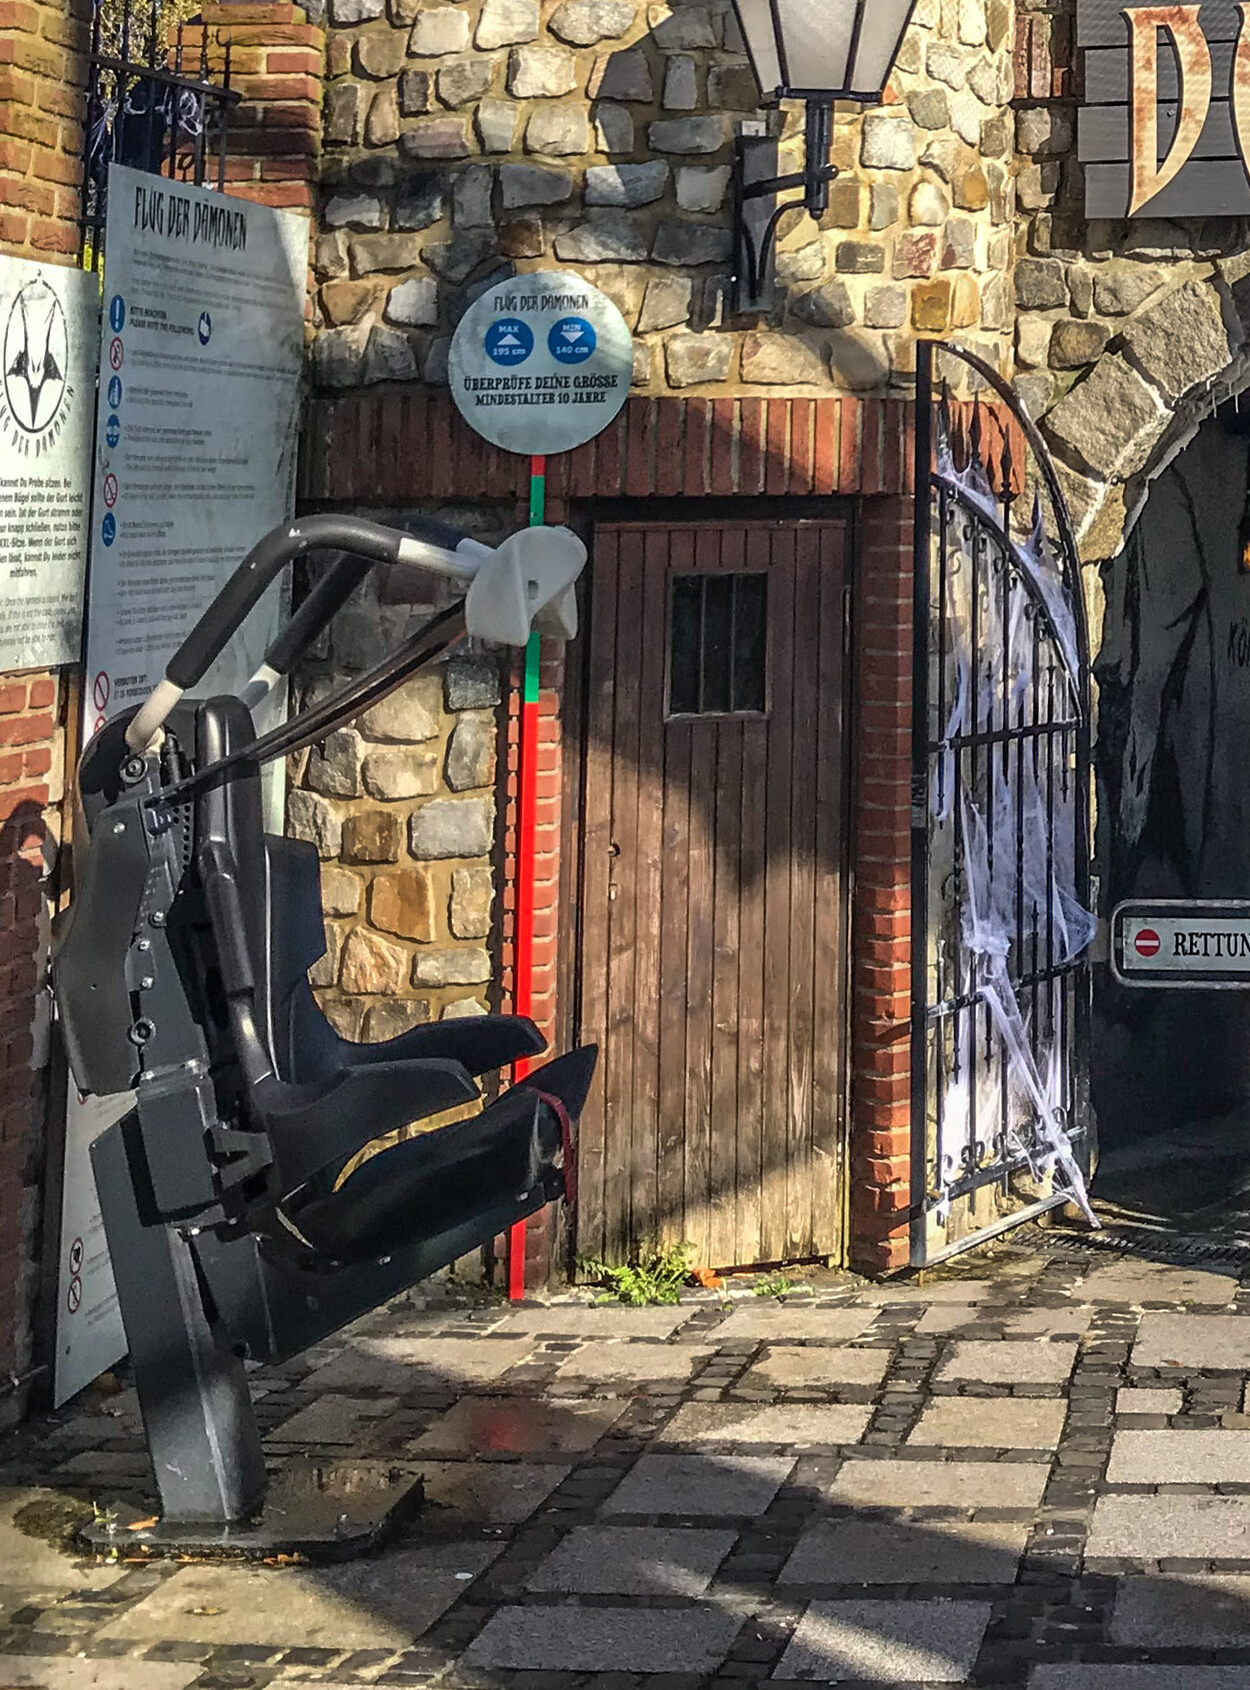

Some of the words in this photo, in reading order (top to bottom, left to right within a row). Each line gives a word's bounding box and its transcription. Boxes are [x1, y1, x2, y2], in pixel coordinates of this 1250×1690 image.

[134, 185, 164, 235] FLUG
[167, 196, 191, 245] DER
[192, 198, 247, 251] DÄMONEN
[494, 295, 518, 312] FLUG
[520, 295, 539, 312] DER
[498, 325, 519, 333] MAX
[562, 324, 581, 332] MIN
[492, 348, 509, 356] 195
[556, 346, 572, 355] 140
[574, 346, 589, 354] cm
[464, 374, 532, 391] ÜBERPRÜFE
[534, 372, 570, 390] DEINE
[573, 374, 618, 389] GRÖSSE
[475, 392, 555, 406] MINDESTALTER
[558, 393, 570, 403] 10
[571, 391, 607, 403] JAHRE
[0, 478, 19, 488] kannst
[19, 478, 27, 488] Du
[28, 478, 44, 488] Probe
[14, 493, 30, 505] Bügel
[30, 492, 45, 503] sollte
[46, 493, 55, 503] der
[56, 493, 68, 503] Gurt
[28, 507, 37, 517] der
[37, 507, 50, 517] Gurt
[71, 508, 83, 517] oder
[8, 523, 25, 536] knapp
[44, 537, 53, 547] der
[54, 536, 66, 547] Gurt
[24, 551, 42, 562] kannst
[51, 550, 68, 561] leider
